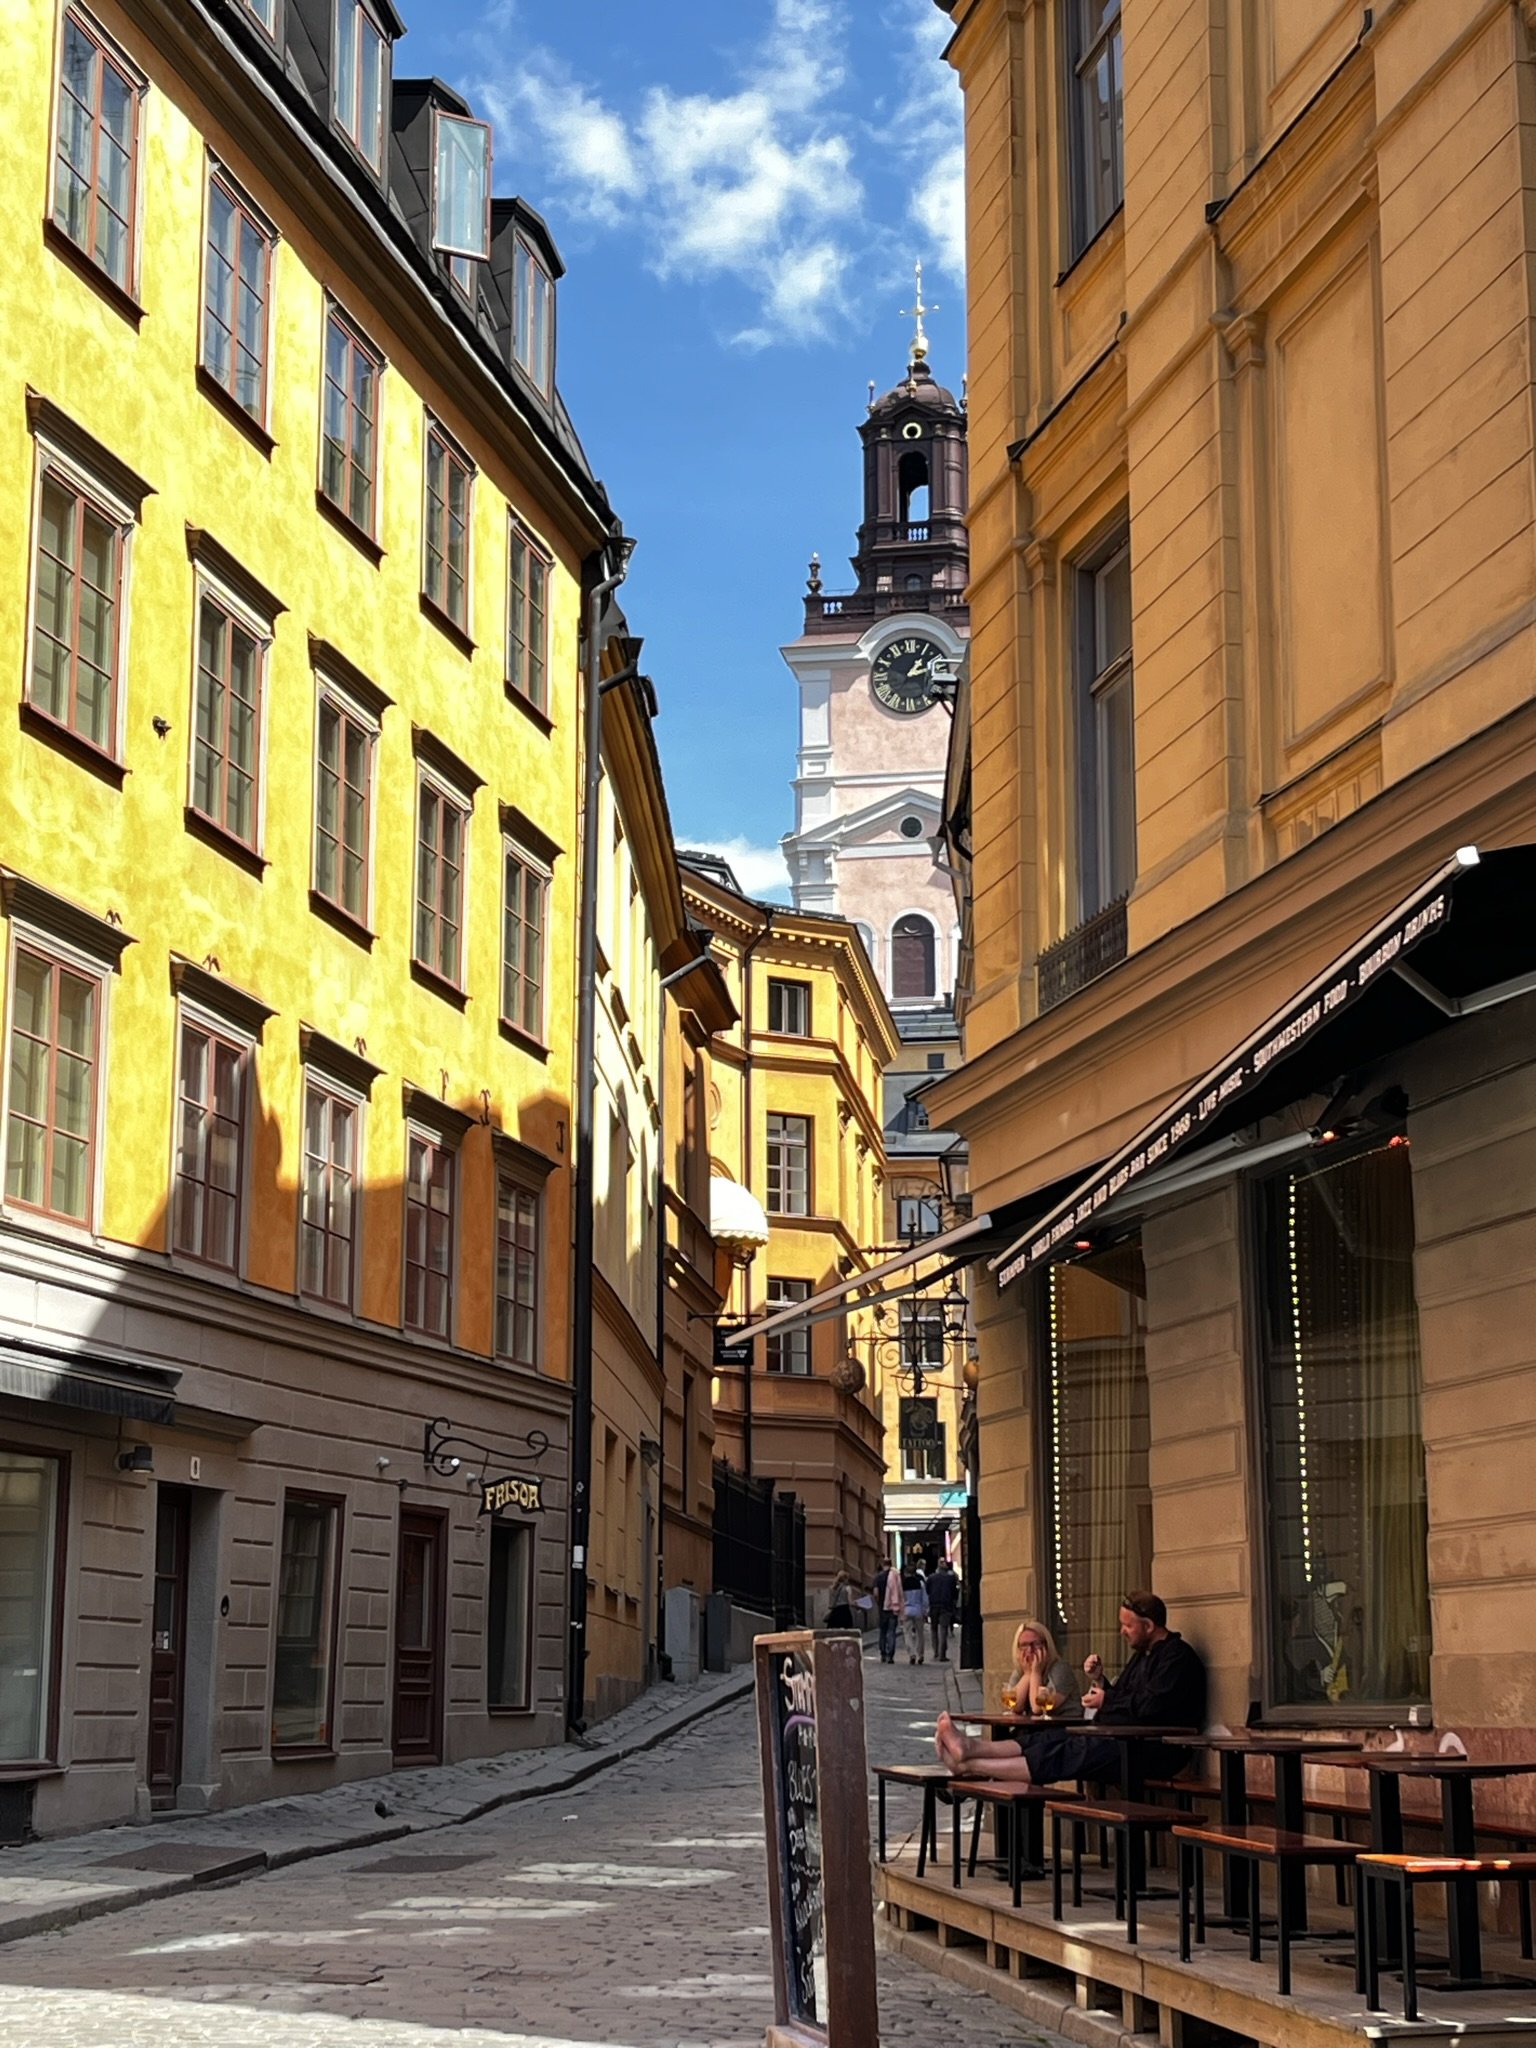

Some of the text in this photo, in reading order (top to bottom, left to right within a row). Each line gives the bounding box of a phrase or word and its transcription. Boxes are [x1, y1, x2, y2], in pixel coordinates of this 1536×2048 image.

[904, 640, 916, 653] XII
[1076, 1197, 1092, 1224] JAZZ
[1093, 1184, 1107, 1210] AND
[1109, 1166, 1129, 1196] BLUES
[1129, 1152, 1145, 1177] BAR
[1147, 1133, 1168, 1164] SINCE
[1170, 1112, 1190, 1144] 1968
[1199, 1090, 1217, 1120] LIVE
[1218, 1067, 1243, 1102] MUSIC
[1254, 1001, 1320, 1073] SOUTHWESTERN
[1324, 980, 1348, 1014] FOOD
[1359, 932, 1402, 985] BOURBON
[1403, 894, 1444, 945] DRINKS
[902, 1438, 936, 1449] TATTOO
